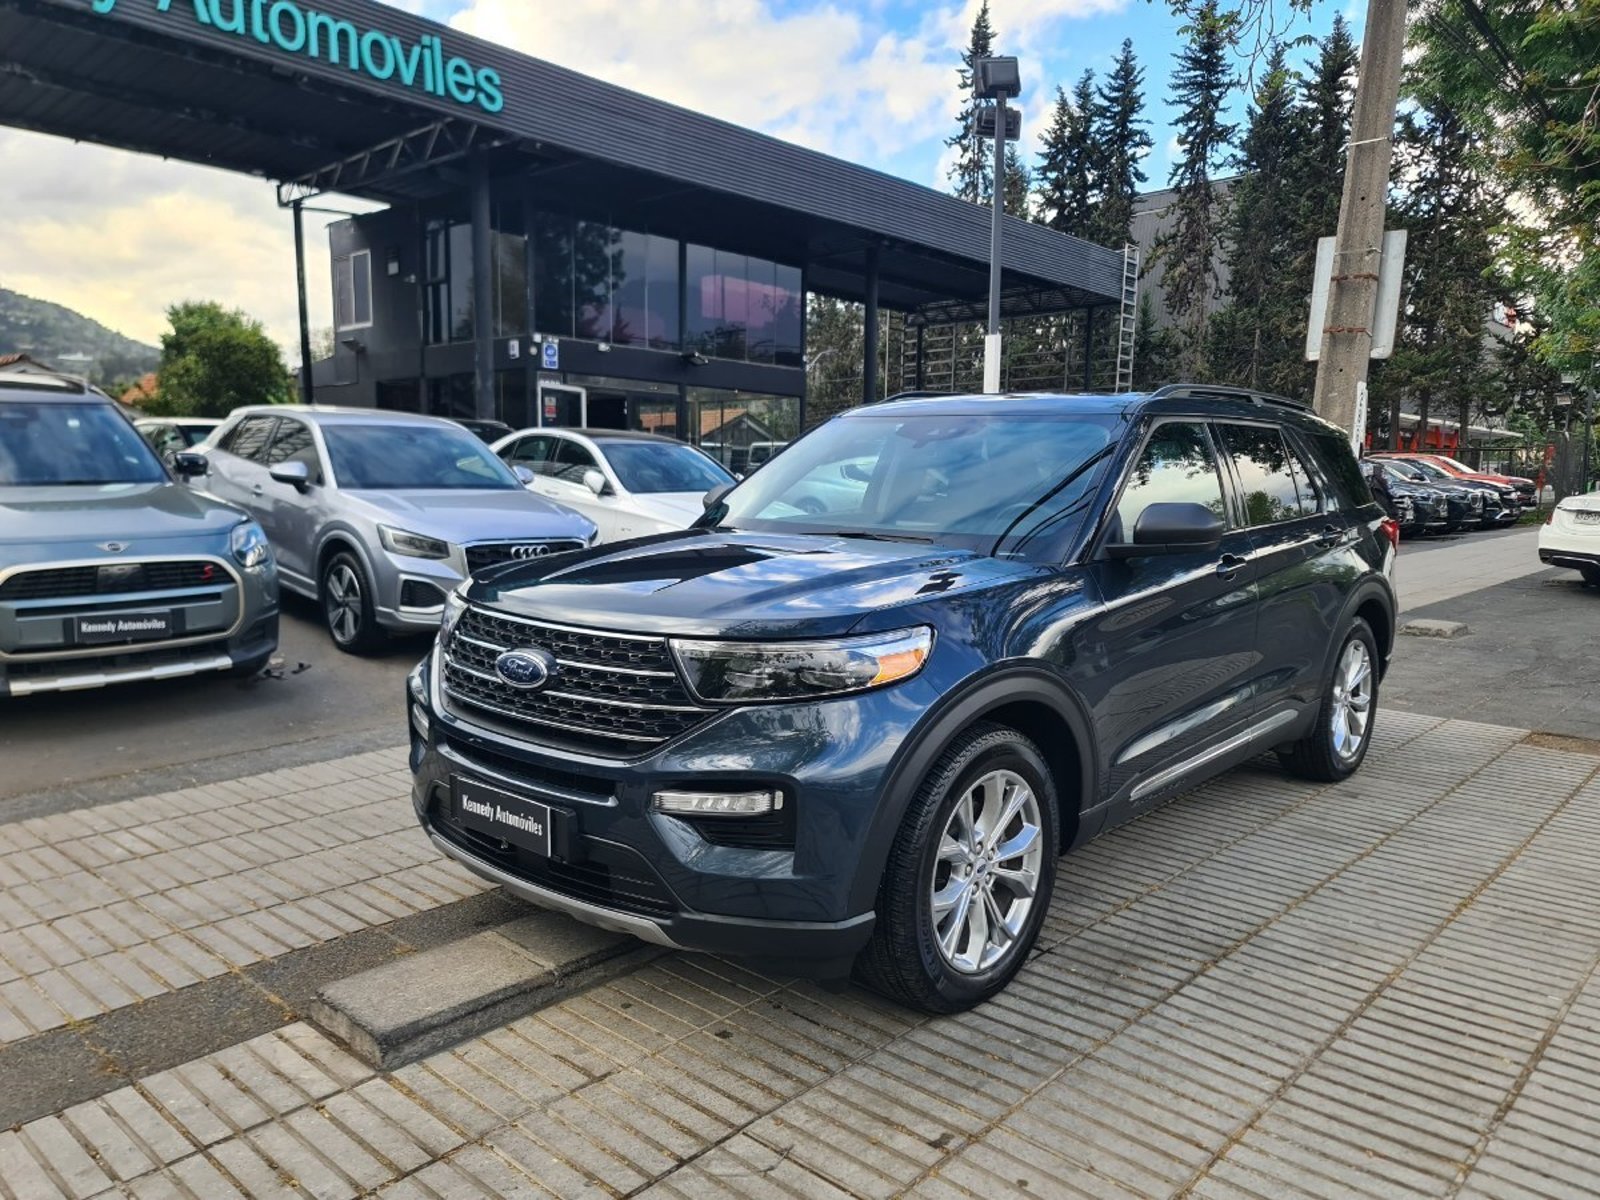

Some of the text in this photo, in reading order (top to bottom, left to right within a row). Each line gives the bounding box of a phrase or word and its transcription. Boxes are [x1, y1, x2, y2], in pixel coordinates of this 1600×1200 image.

[156, 0, 504, 112] utomoviles
[81, 620, 116, 634] Kennedy
[462, 794, 543, 837] Kennedy Automóviles
